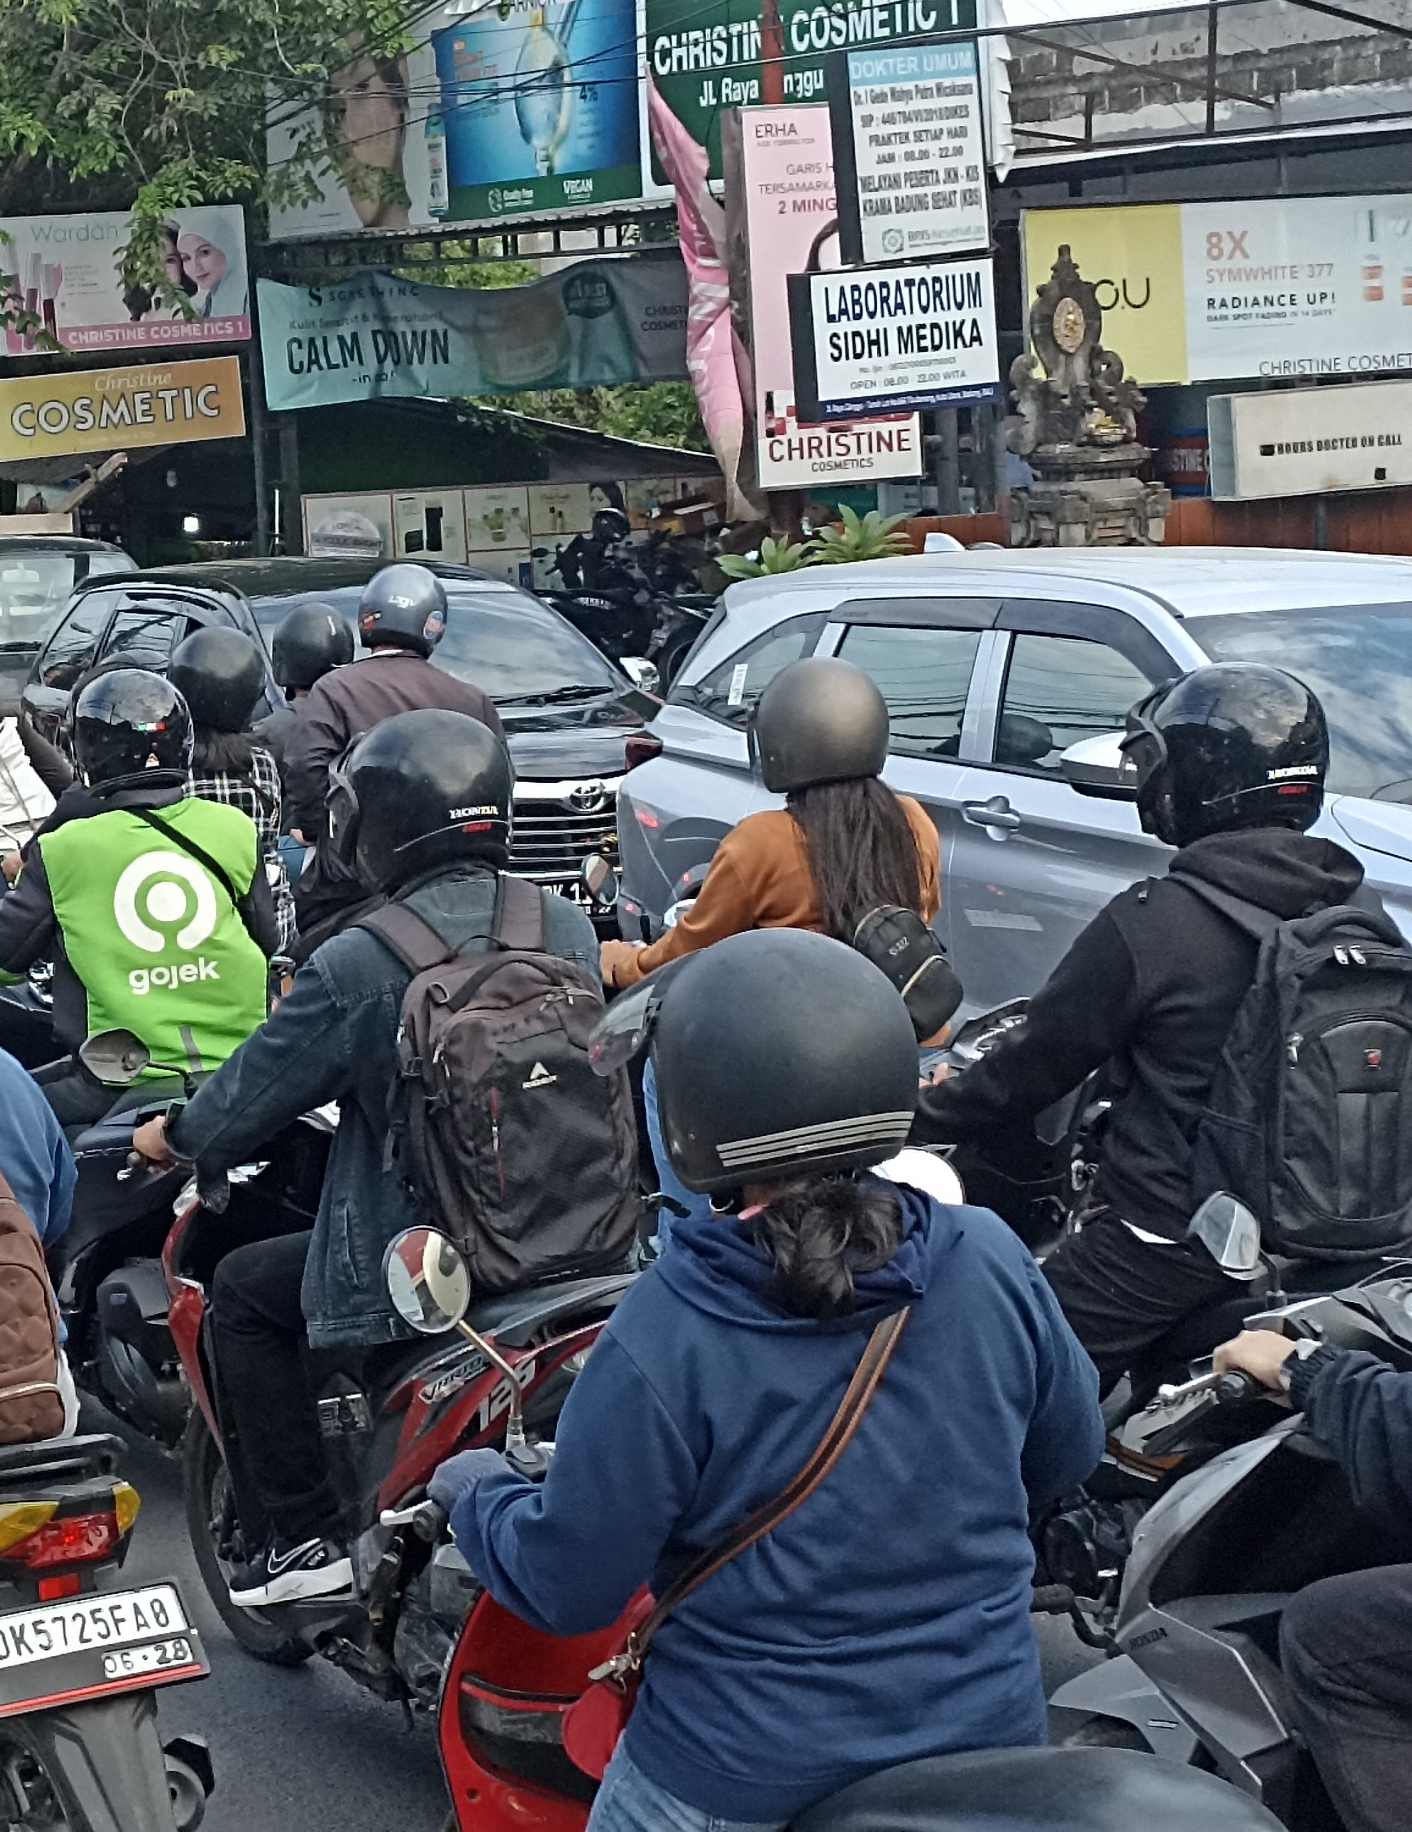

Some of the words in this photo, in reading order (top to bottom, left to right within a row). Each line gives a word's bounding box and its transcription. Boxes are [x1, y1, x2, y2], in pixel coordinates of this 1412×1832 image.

[654, 16, 766, 76] CHRISTIN
[791, 0, 937, 52] COSMETIC
[850, 56, 918, 81] DOKTER
[923, 51, 975, 74] UMUM
[722, 77, 759, 107] Raya
[782, 69, 824, 99] nggu
[754, 122, 798, 139] ERHA
[868, 131, 910, 147] PRAKTEK
[913, 127, 944, 143] SETIAP
[786, 162, 823, 176] GARIS
[778, 200, 787, 215] 2
[792, 197, 837, 214] MING
[30, 222, 118, 244] Wardah
[1205, 230, 1250, 262] 8X
[1206, 264, 1299, 284] SYMWHITE
[1307, 263, 1334, 279] 377
[824, 271, 983, 324] LABORATORIUM
[1206, 293, 1298, 311] RADIANCE
[1306, 291, 1337, 306] UP!
[68, 327, 146, 345] CHRISTINE
[150, 320, 234, 340] COSMETICS
[829, 326, 889, 362] SIDHI
[897, 317, 984, 356] MEDIKA
[286, 330, 365, 375] CALM
[371, 328, 450, 367] DOWN
[942, 369, 967, 381] WITA
[1259, 357, 1342, 376] CHRISTINE
[94, 369, 172, 393] Christine
[10, 383, 222, 437] COSMETIC
[768, 428, 912, 463] CHRISTINE
[1277, 440, 1314, 455] HOURS
[1377, 433, 1402, 447] CALL
[811, 457, 874, 473] COSMETICS
[449, 804, 499, 819] HONDA
[128, 956, 221, 996] gojek
